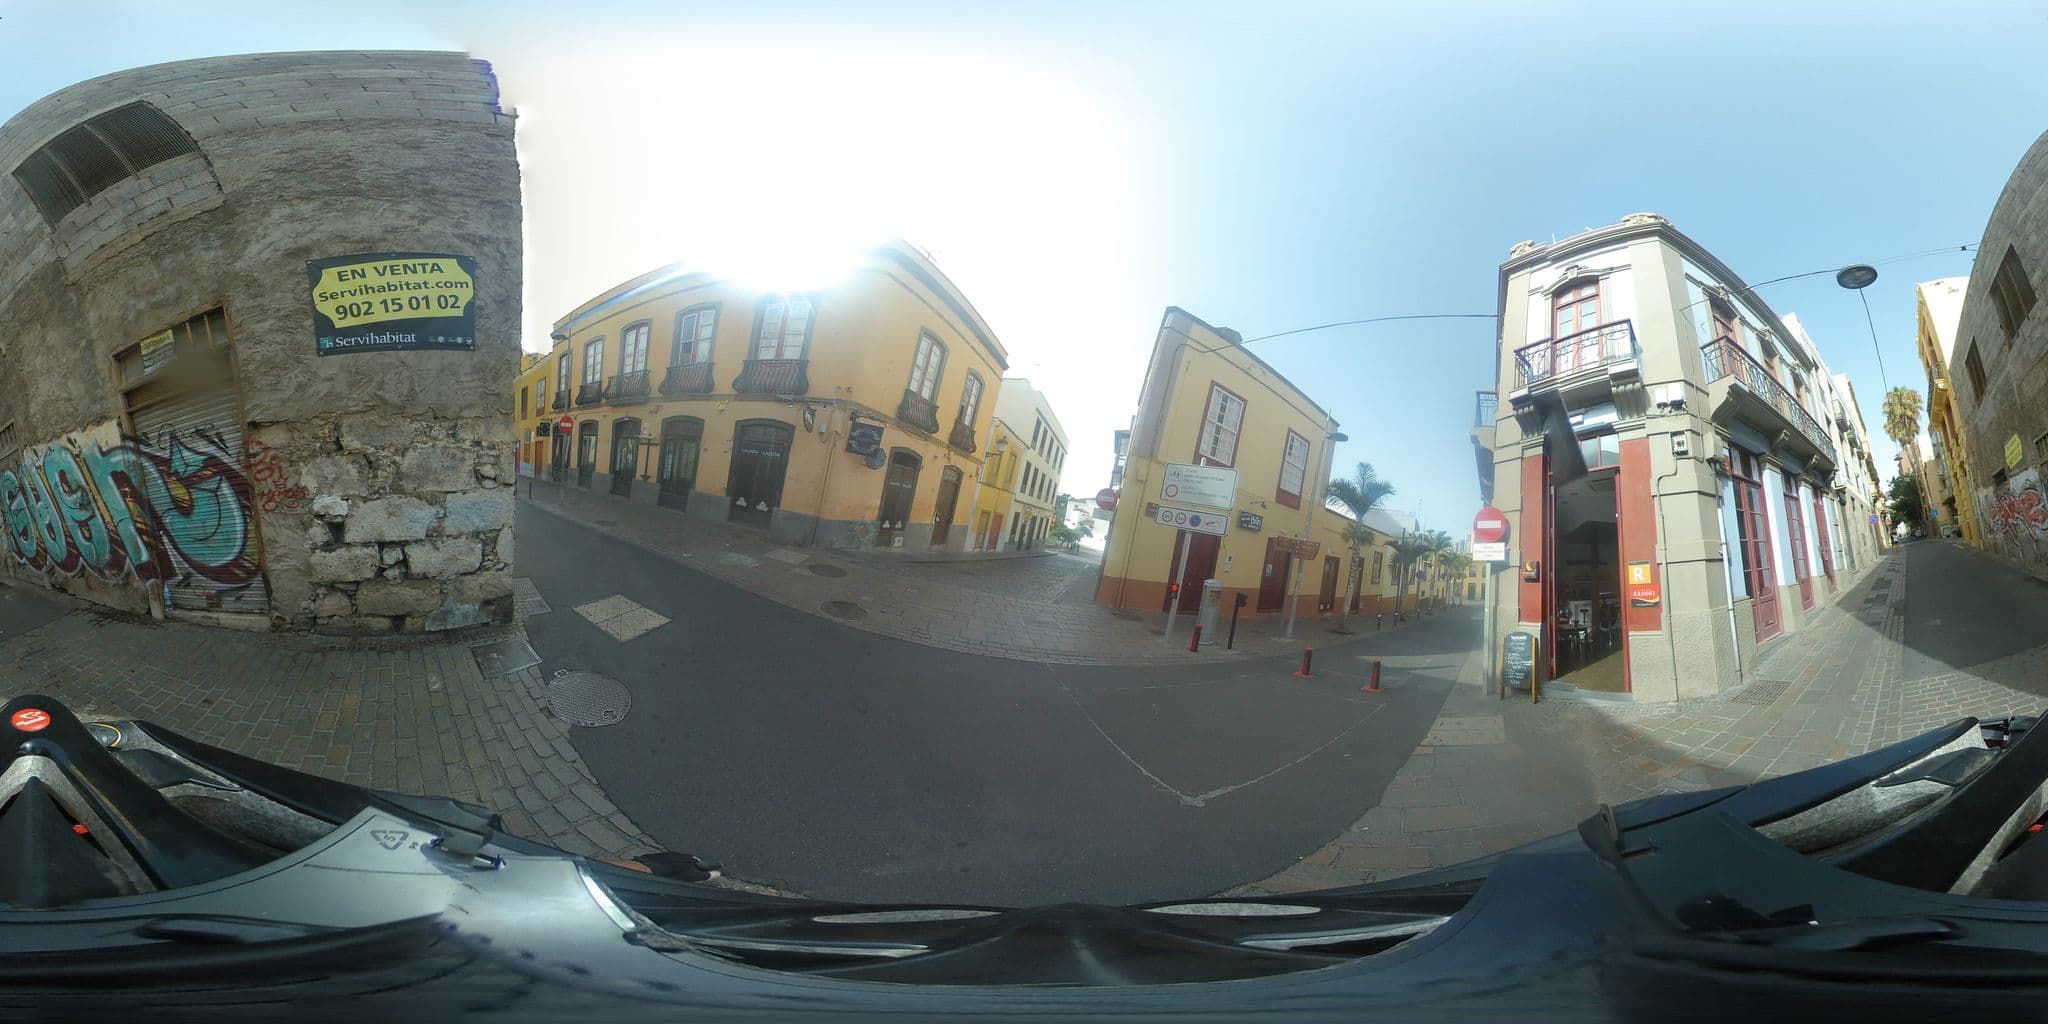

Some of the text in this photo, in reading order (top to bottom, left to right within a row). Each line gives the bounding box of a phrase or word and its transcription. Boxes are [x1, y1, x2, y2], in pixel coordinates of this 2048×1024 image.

[336, 261, 445, 283] EN VENTA
[318, 279, 469, 303] Servihabitat.com
[335, 294, 461, 321] 902 15 01 02
[335, 331, 417, 348] Servihabitat
[1633, 567, 1645, 581] R
